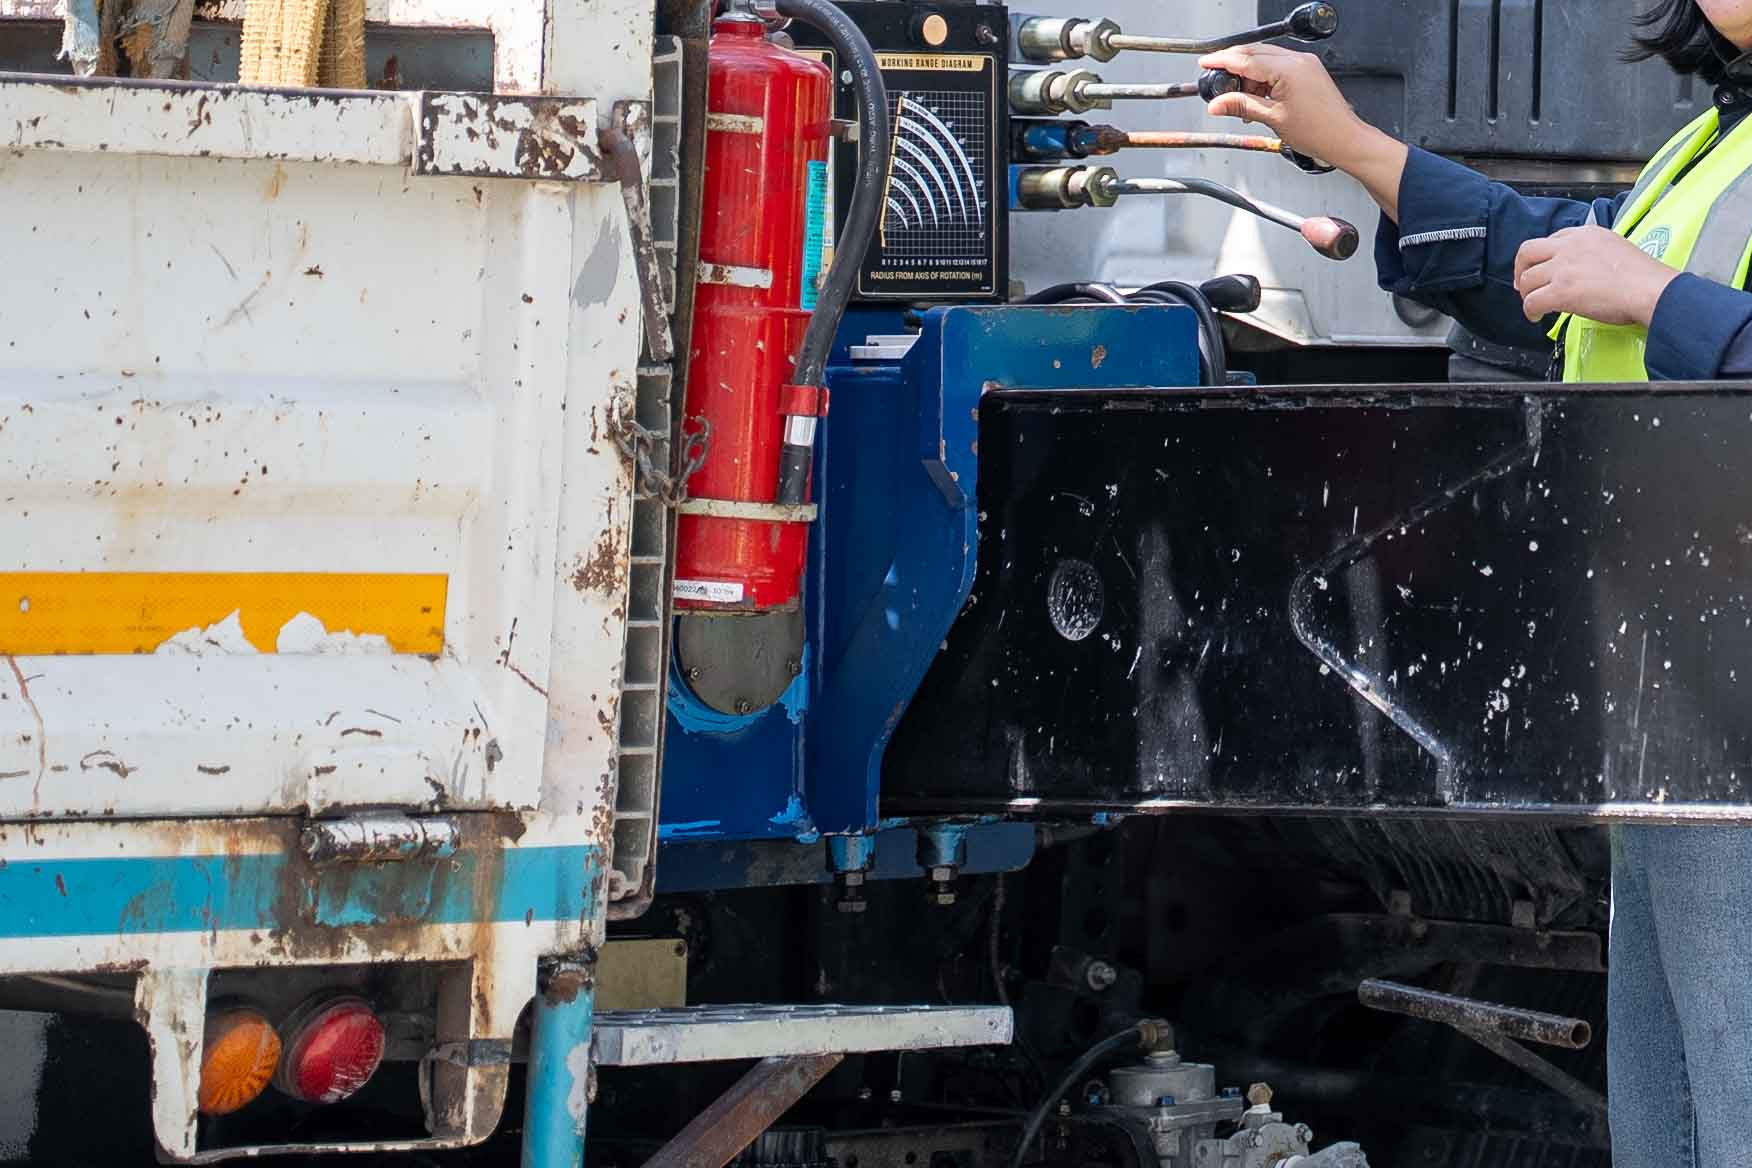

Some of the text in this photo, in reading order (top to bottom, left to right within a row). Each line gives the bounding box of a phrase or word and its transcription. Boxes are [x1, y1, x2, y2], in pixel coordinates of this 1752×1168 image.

[881, 58, 973, 69] WORKING RANGE DIAGRAM
[870, 271, 894, 280] RADIUS
[895, 271, 914, 280] FROM
[914, 271, 930, 280] AXIS
[930, 272, 939, 280] OF
[940, 272, 971, 280] ROTATION
